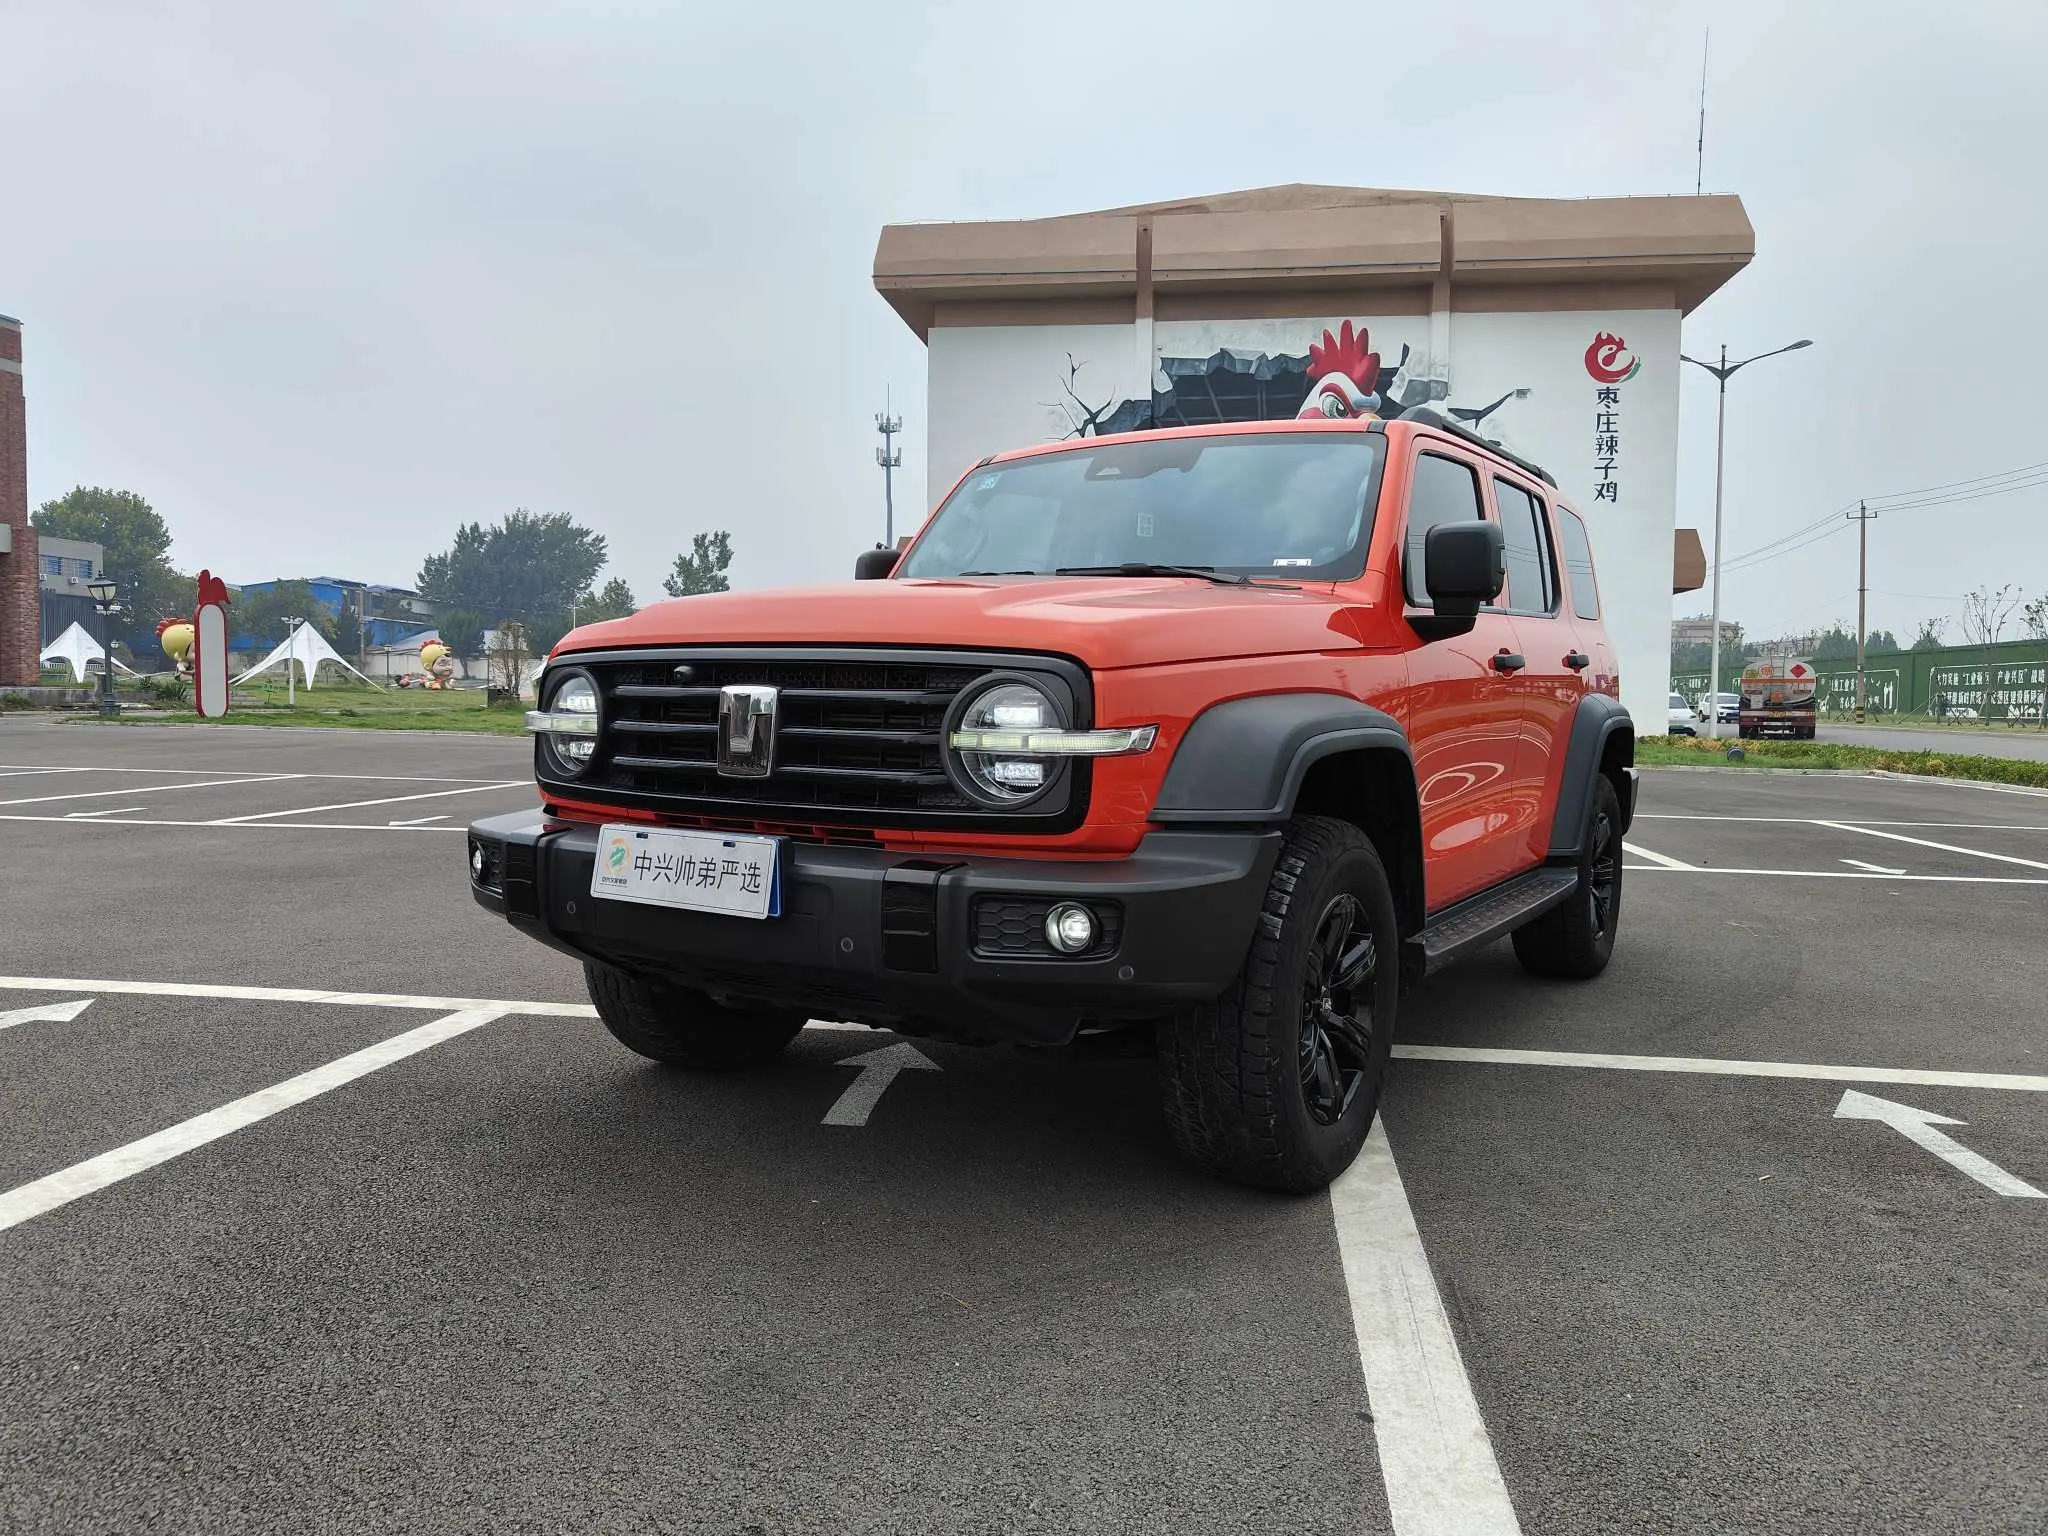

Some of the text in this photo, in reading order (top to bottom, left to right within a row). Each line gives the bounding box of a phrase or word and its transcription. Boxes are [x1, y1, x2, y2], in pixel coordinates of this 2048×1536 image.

[1593, 386, 1620, 503] 枣庄辣子鸡
[634, 849, 762, 894] 中兴帅弟严选
